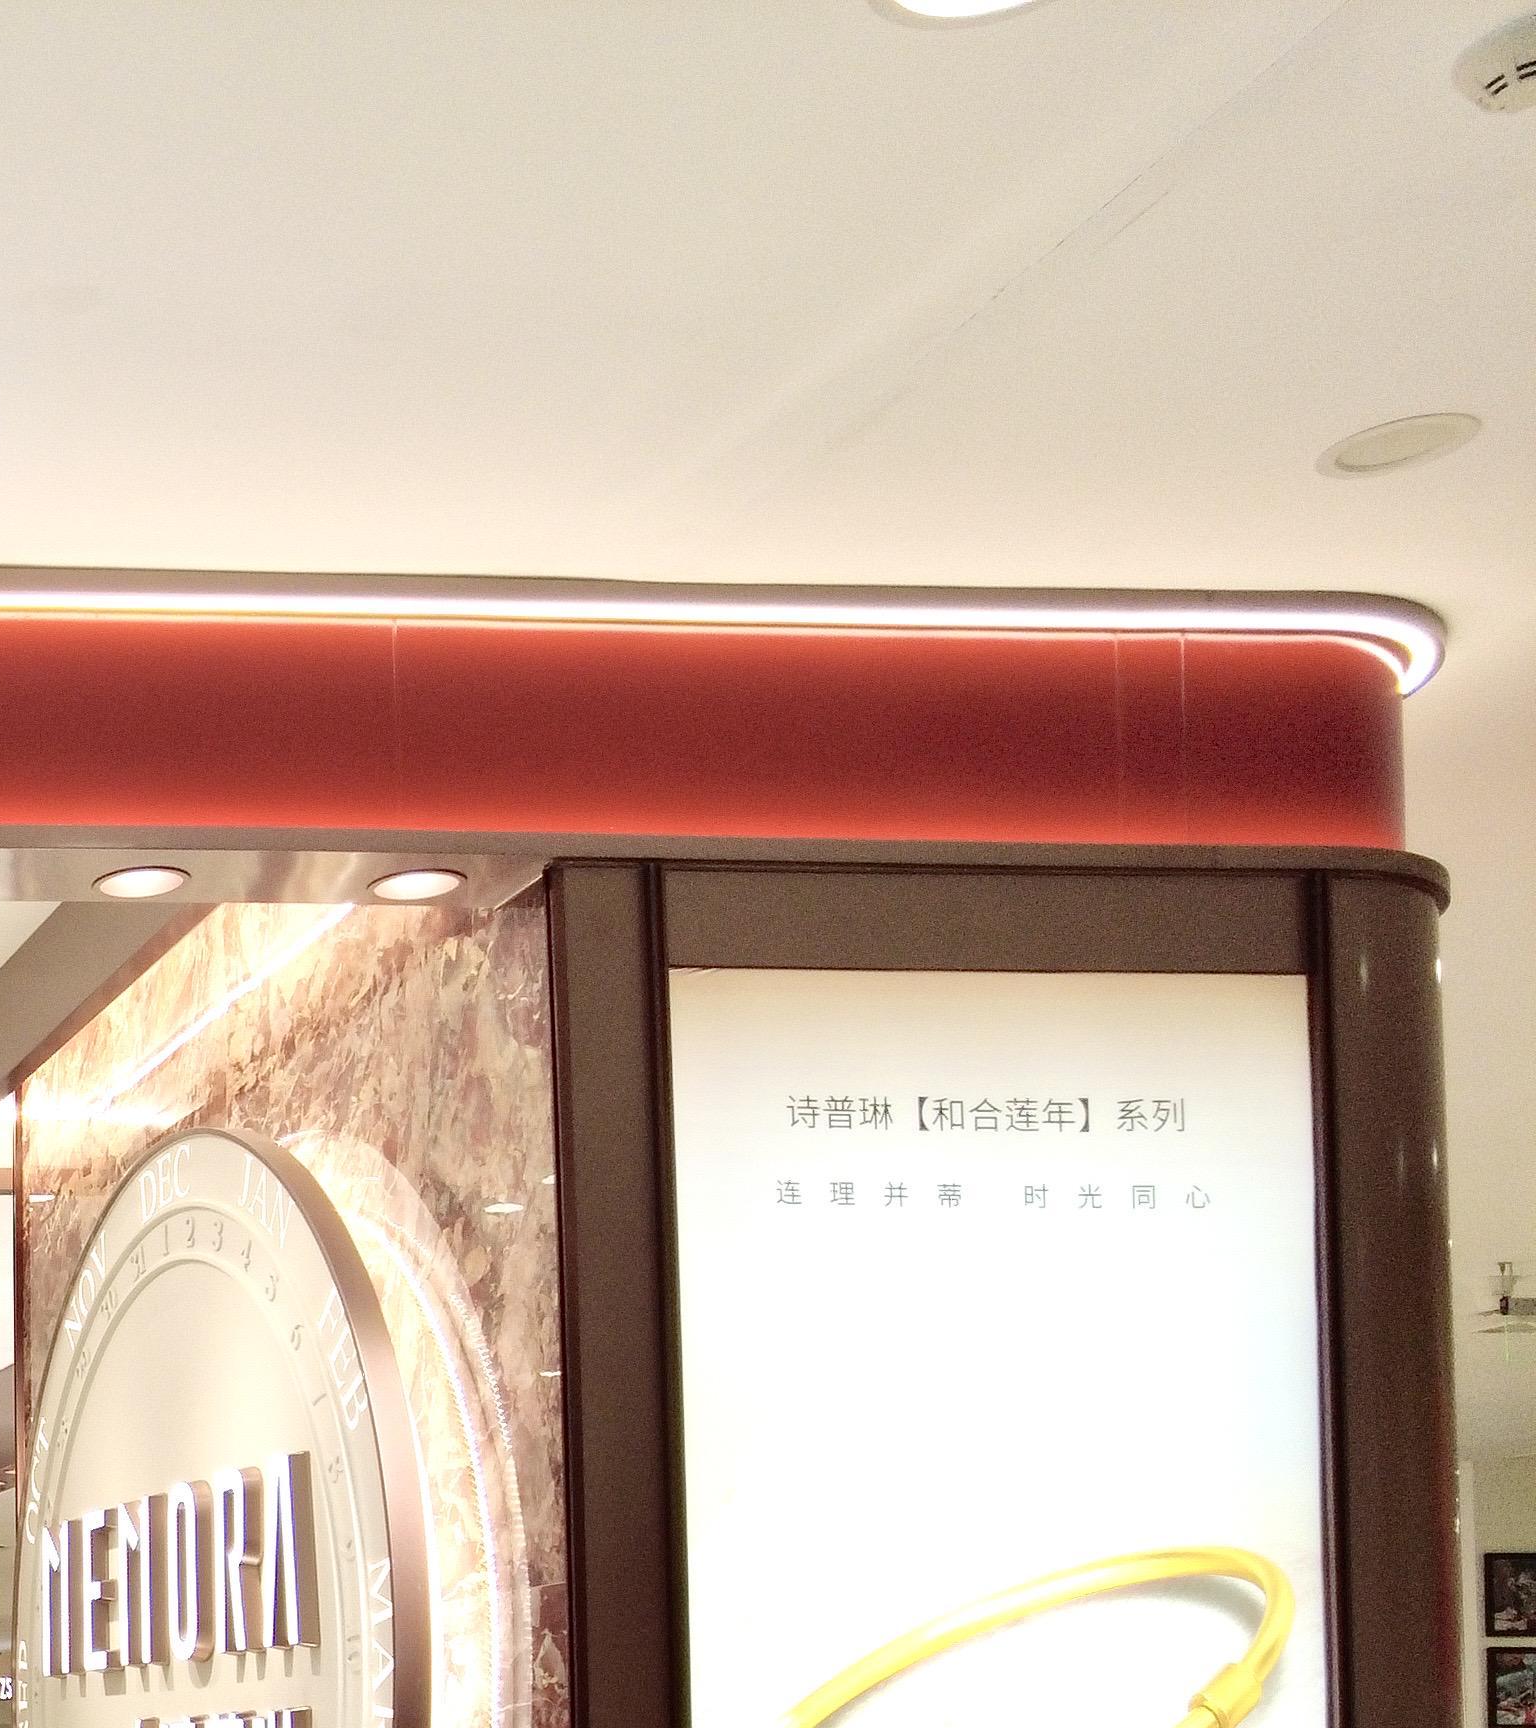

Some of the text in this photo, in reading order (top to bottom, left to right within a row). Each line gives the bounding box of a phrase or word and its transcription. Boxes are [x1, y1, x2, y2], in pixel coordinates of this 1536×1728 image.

[138, 1143, 191, 1225] DEC
[238, 1152, 295, 1248] JAN
[63, 1230, 107, 1352] NOV
[318, 1285, 369, 1431] FEB
[26, 1416, 49, 1546] OCT
[42, 1451, 312, 1678] MEMORA
